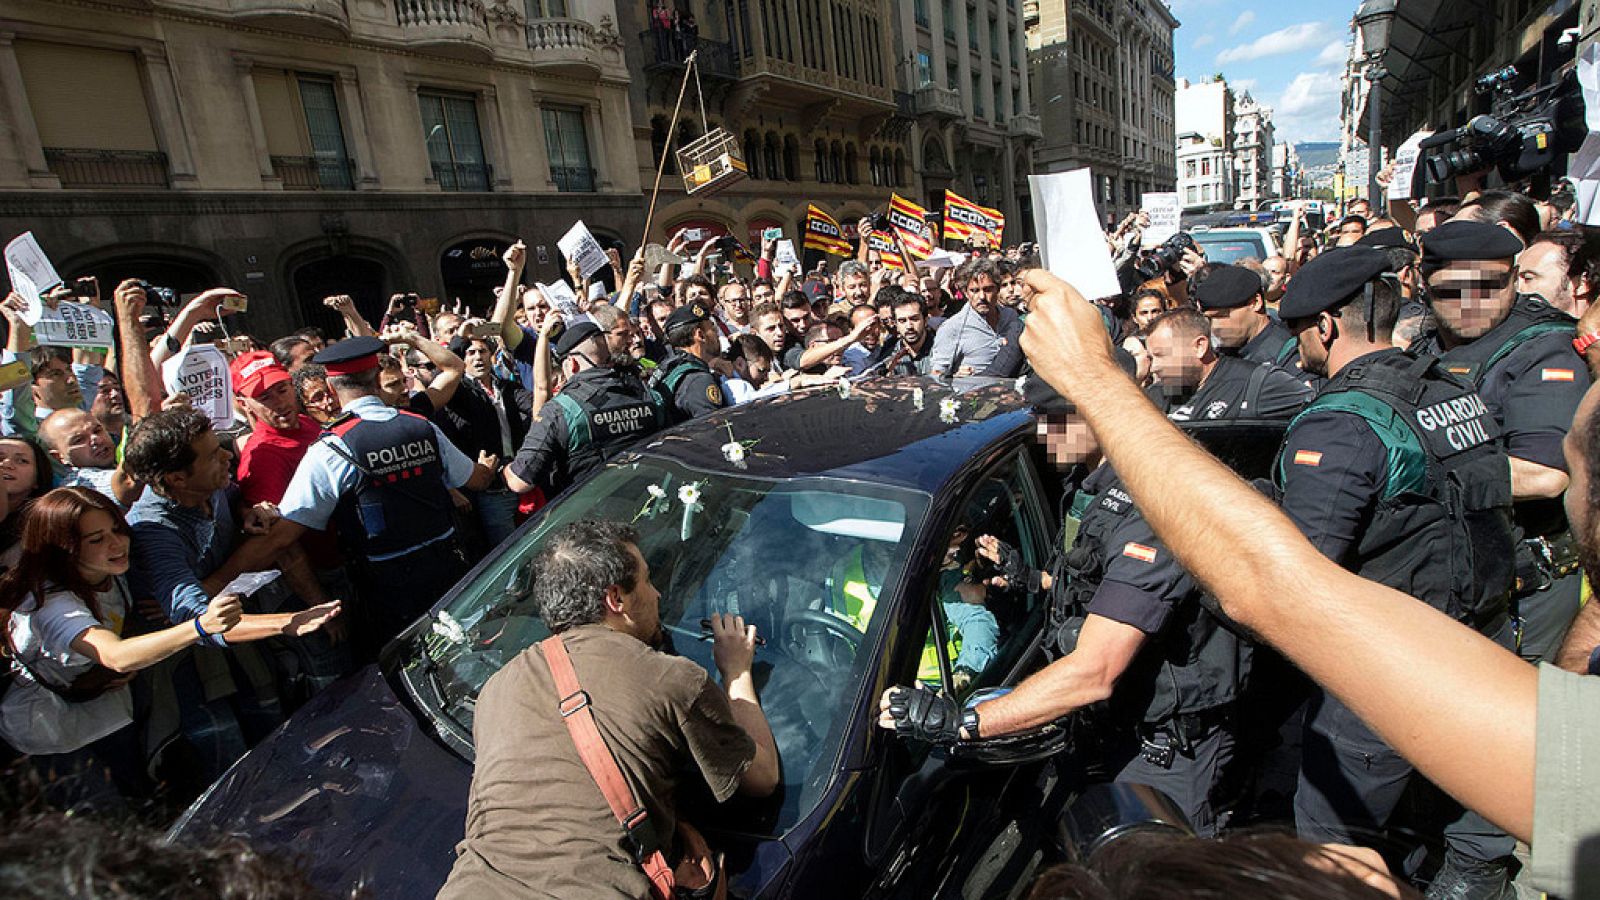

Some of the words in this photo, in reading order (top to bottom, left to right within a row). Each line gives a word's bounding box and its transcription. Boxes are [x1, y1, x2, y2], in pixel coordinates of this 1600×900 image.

[891, 211, 921, 234] CCOO
[951, 206, 985, 226] CCOO
[811, 220, 839, 236] CCOO
[593, 405, 653, 425] GUARDIA
[1416, 393, 1489, 431] GUARDIA
[608, 420, 644, 434] CIVIL
[1446, 418, 1490, 450] CIVIL
[366, 440, 435, 468] POLICIA
